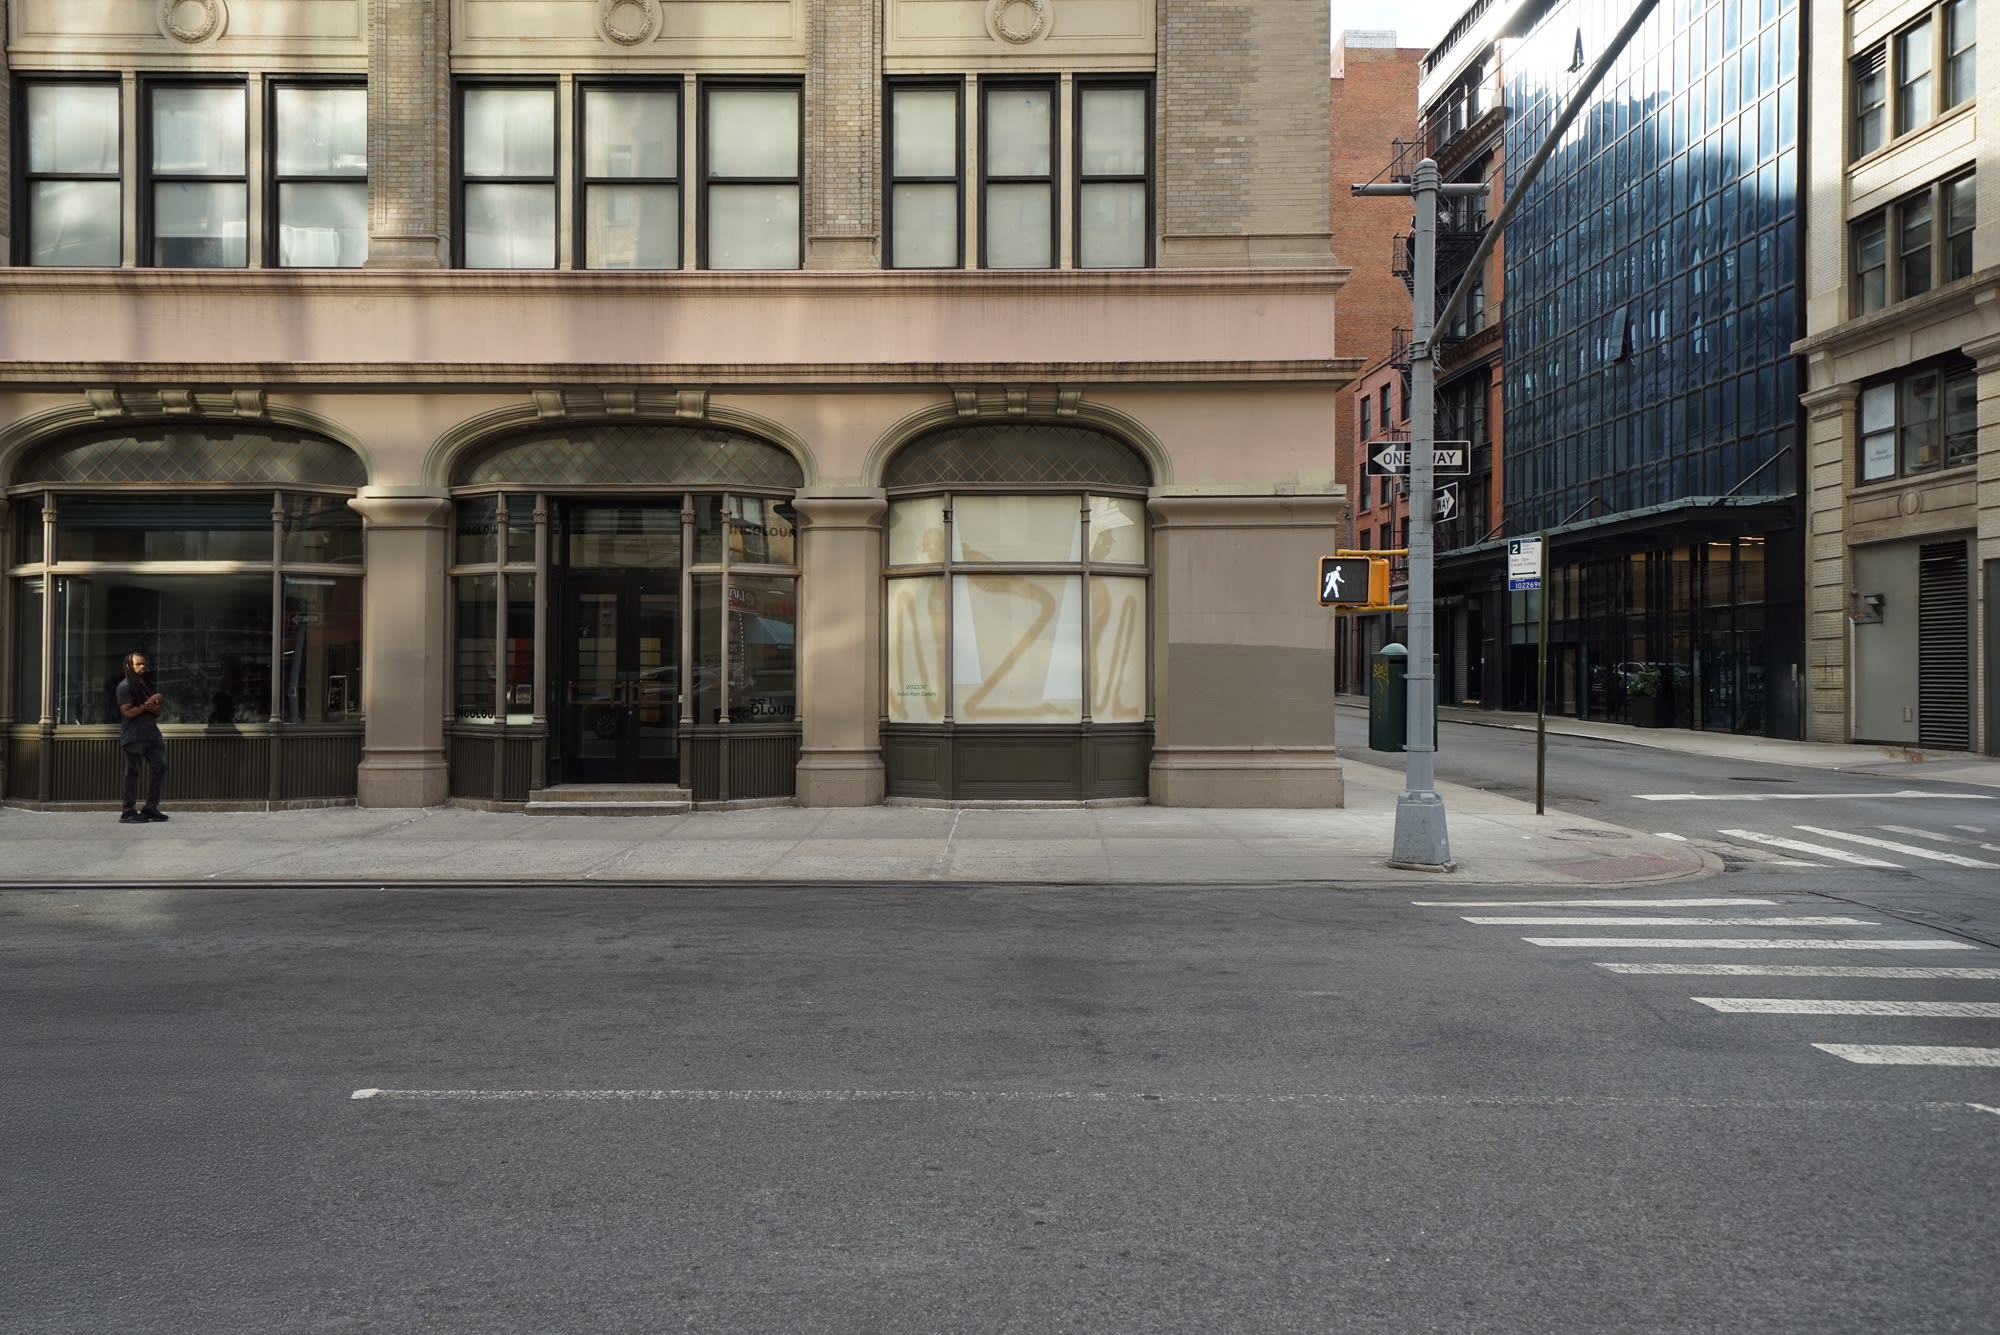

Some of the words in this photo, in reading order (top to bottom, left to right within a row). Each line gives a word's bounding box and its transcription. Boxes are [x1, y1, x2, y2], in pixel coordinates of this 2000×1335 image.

[1383, 452, 1411, 465] ONE
[1433, 452, 1456, 464] AY
[1512, 544, 1518, 554] 2
[456, 708, 497, 719] INCOLOU
